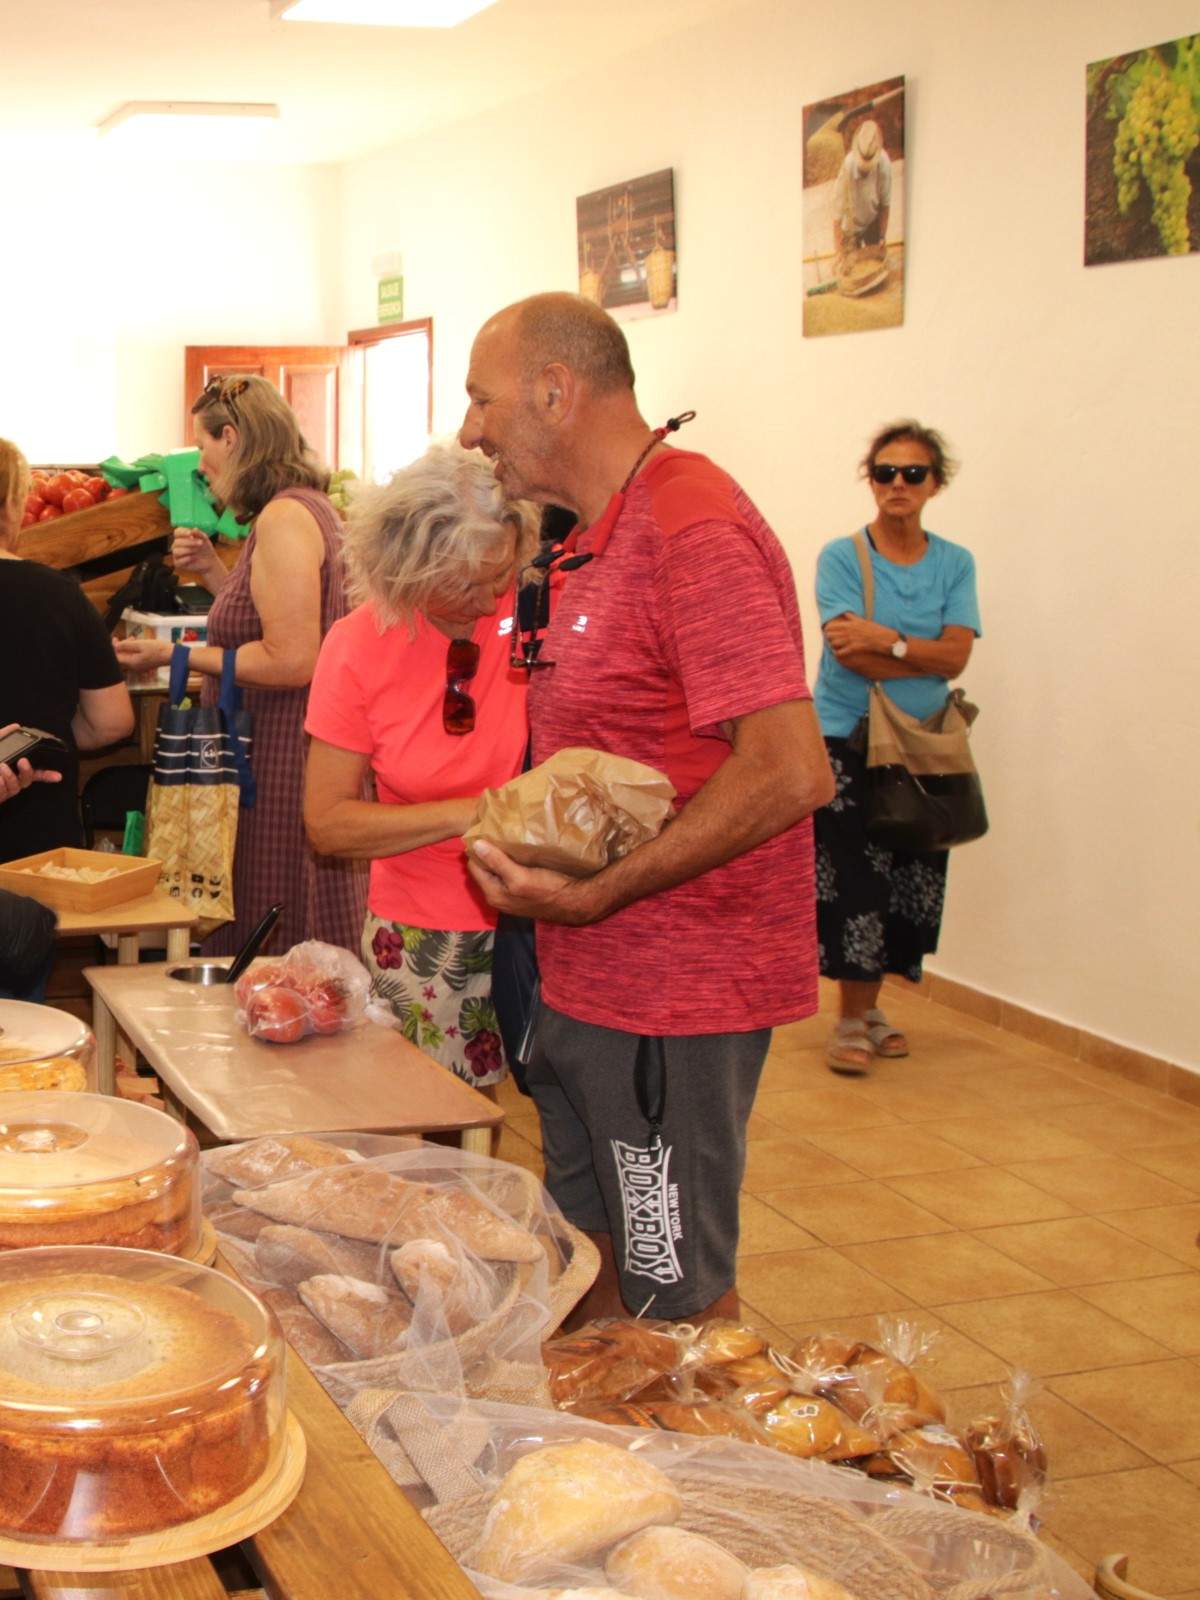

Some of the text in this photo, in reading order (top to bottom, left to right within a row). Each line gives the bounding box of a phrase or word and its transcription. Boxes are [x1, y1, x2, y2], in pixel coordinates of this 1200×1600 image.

[614, 1139, 679, 1284] BOXBOY
[668, 1183, 684, 1241] NEW YORK
